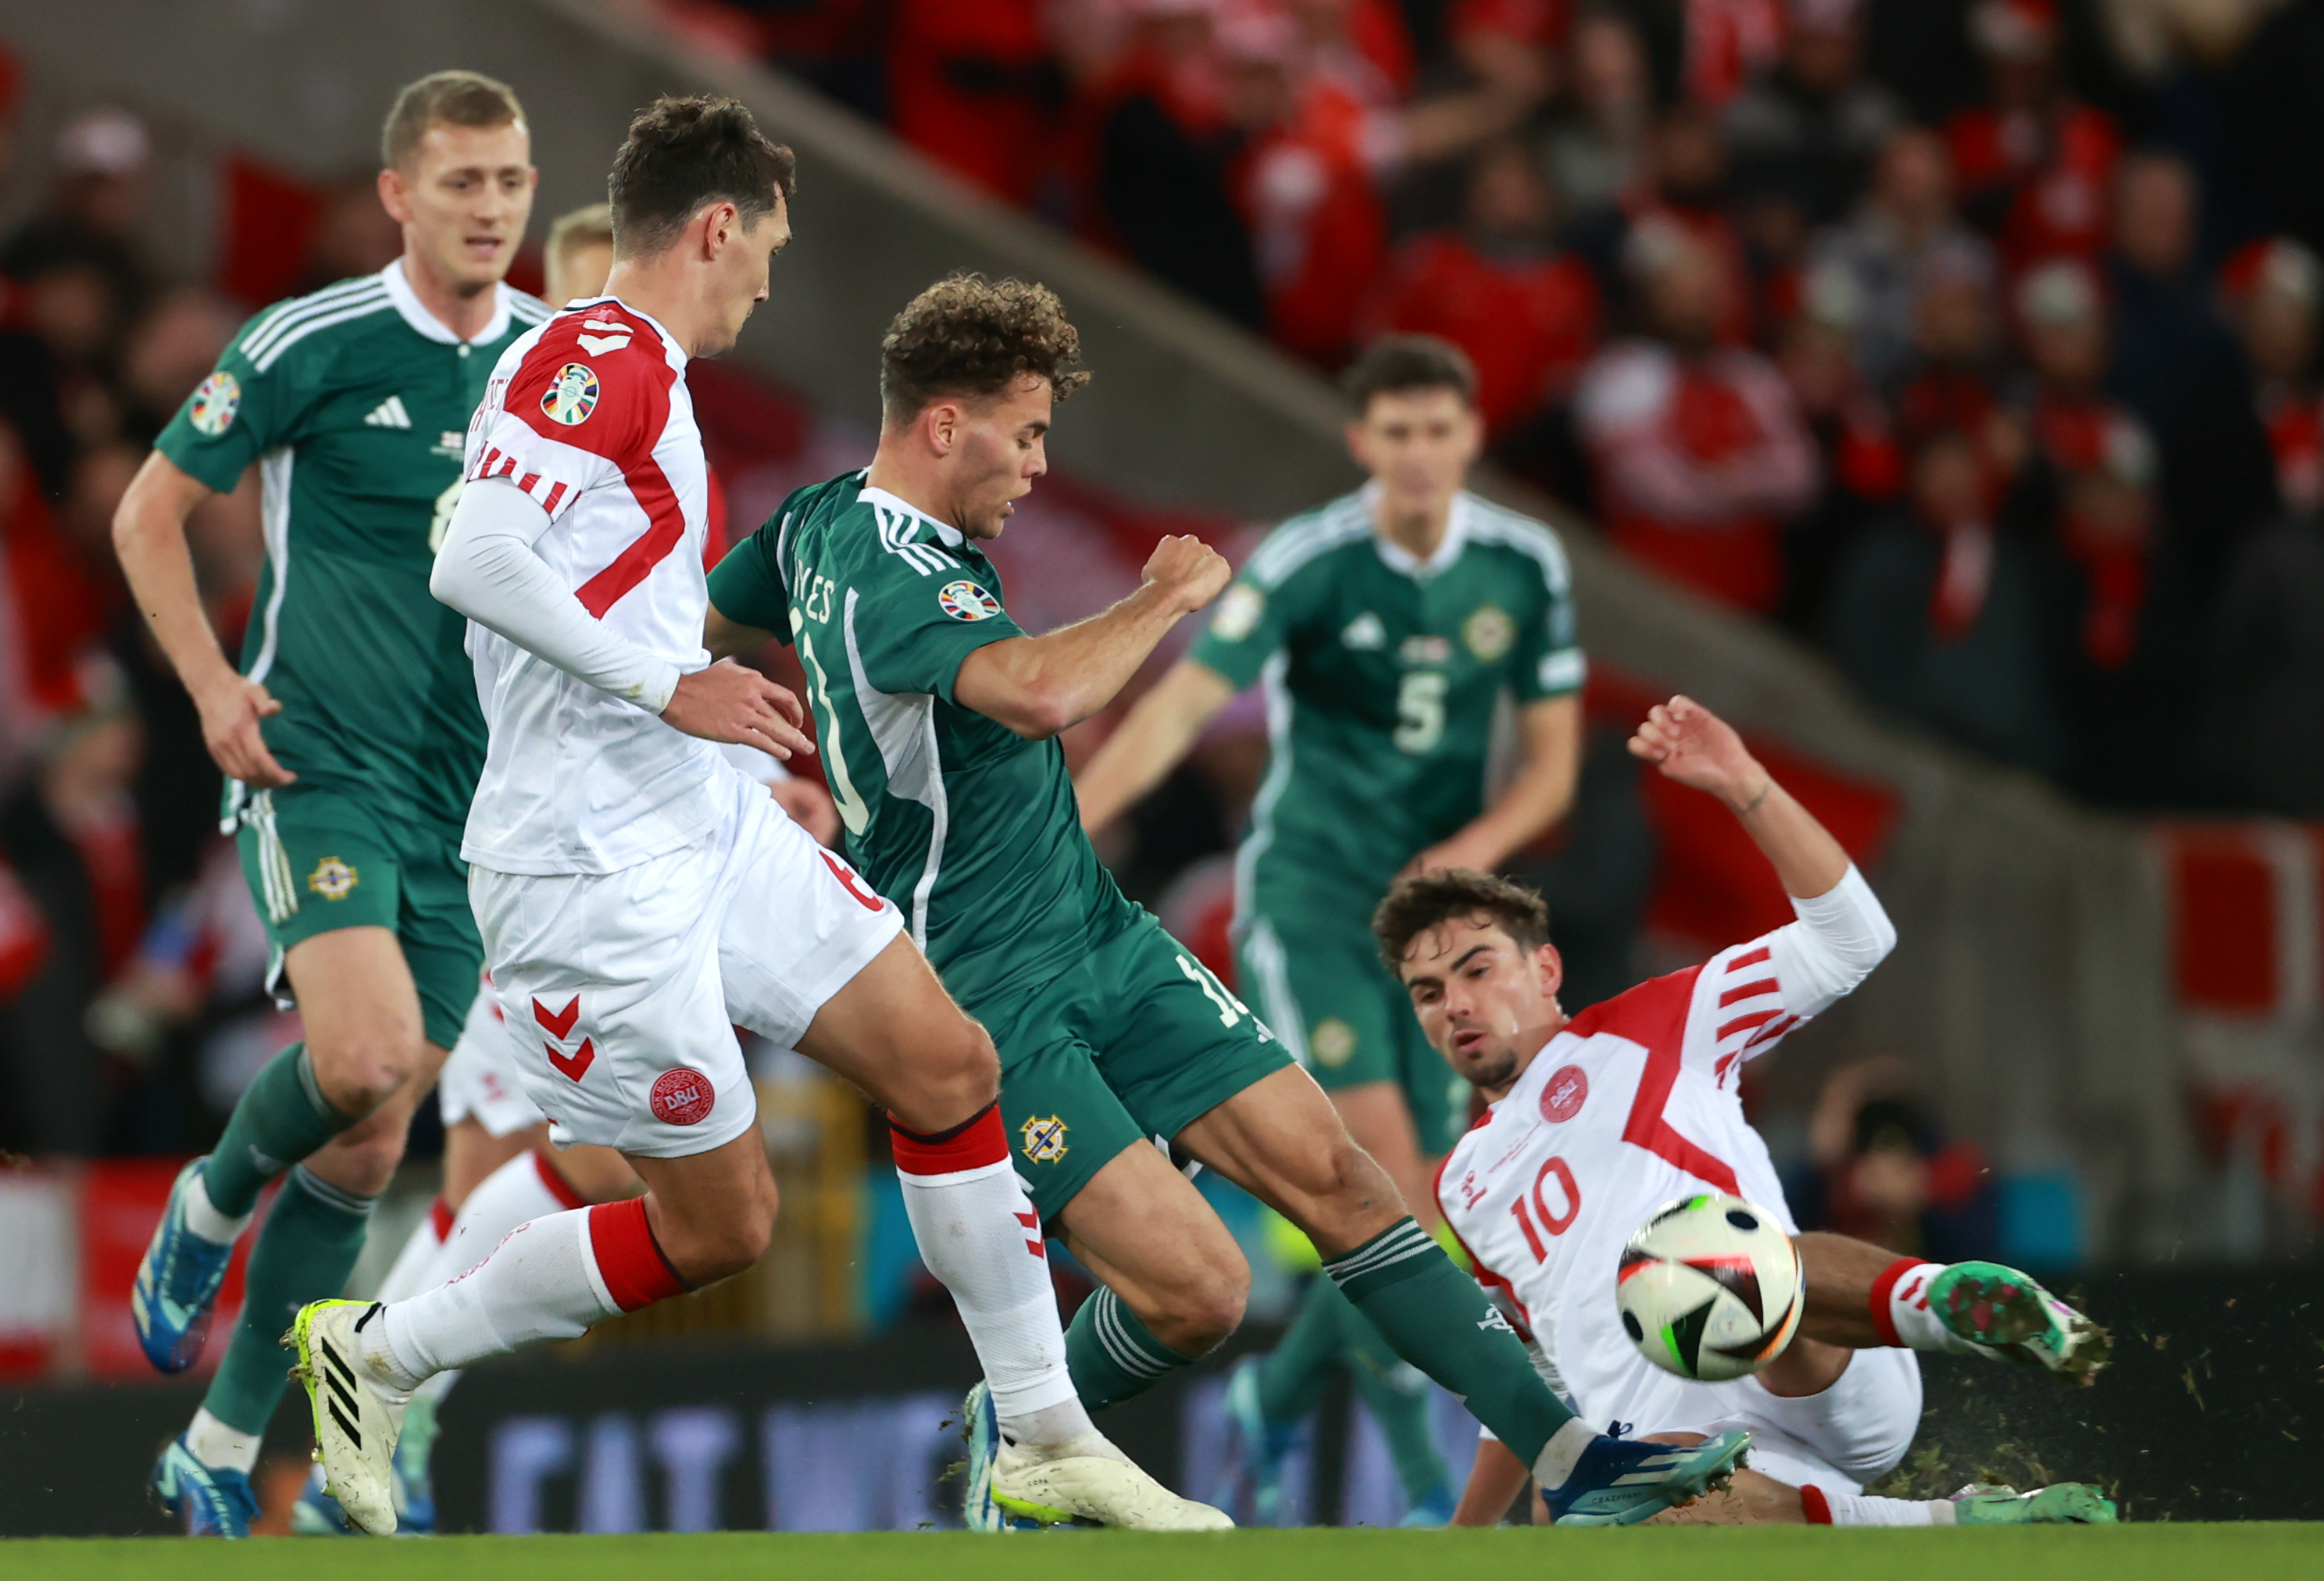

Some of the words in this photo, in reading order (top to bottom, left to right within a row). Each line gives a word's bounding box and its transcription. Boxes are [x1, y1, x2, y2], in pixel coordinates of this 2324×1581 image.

[1393, 672, 1449, 755] 5
[664, 1085, 701, 1111] DBU
[1510, 1156, 1581, 1265] 10
